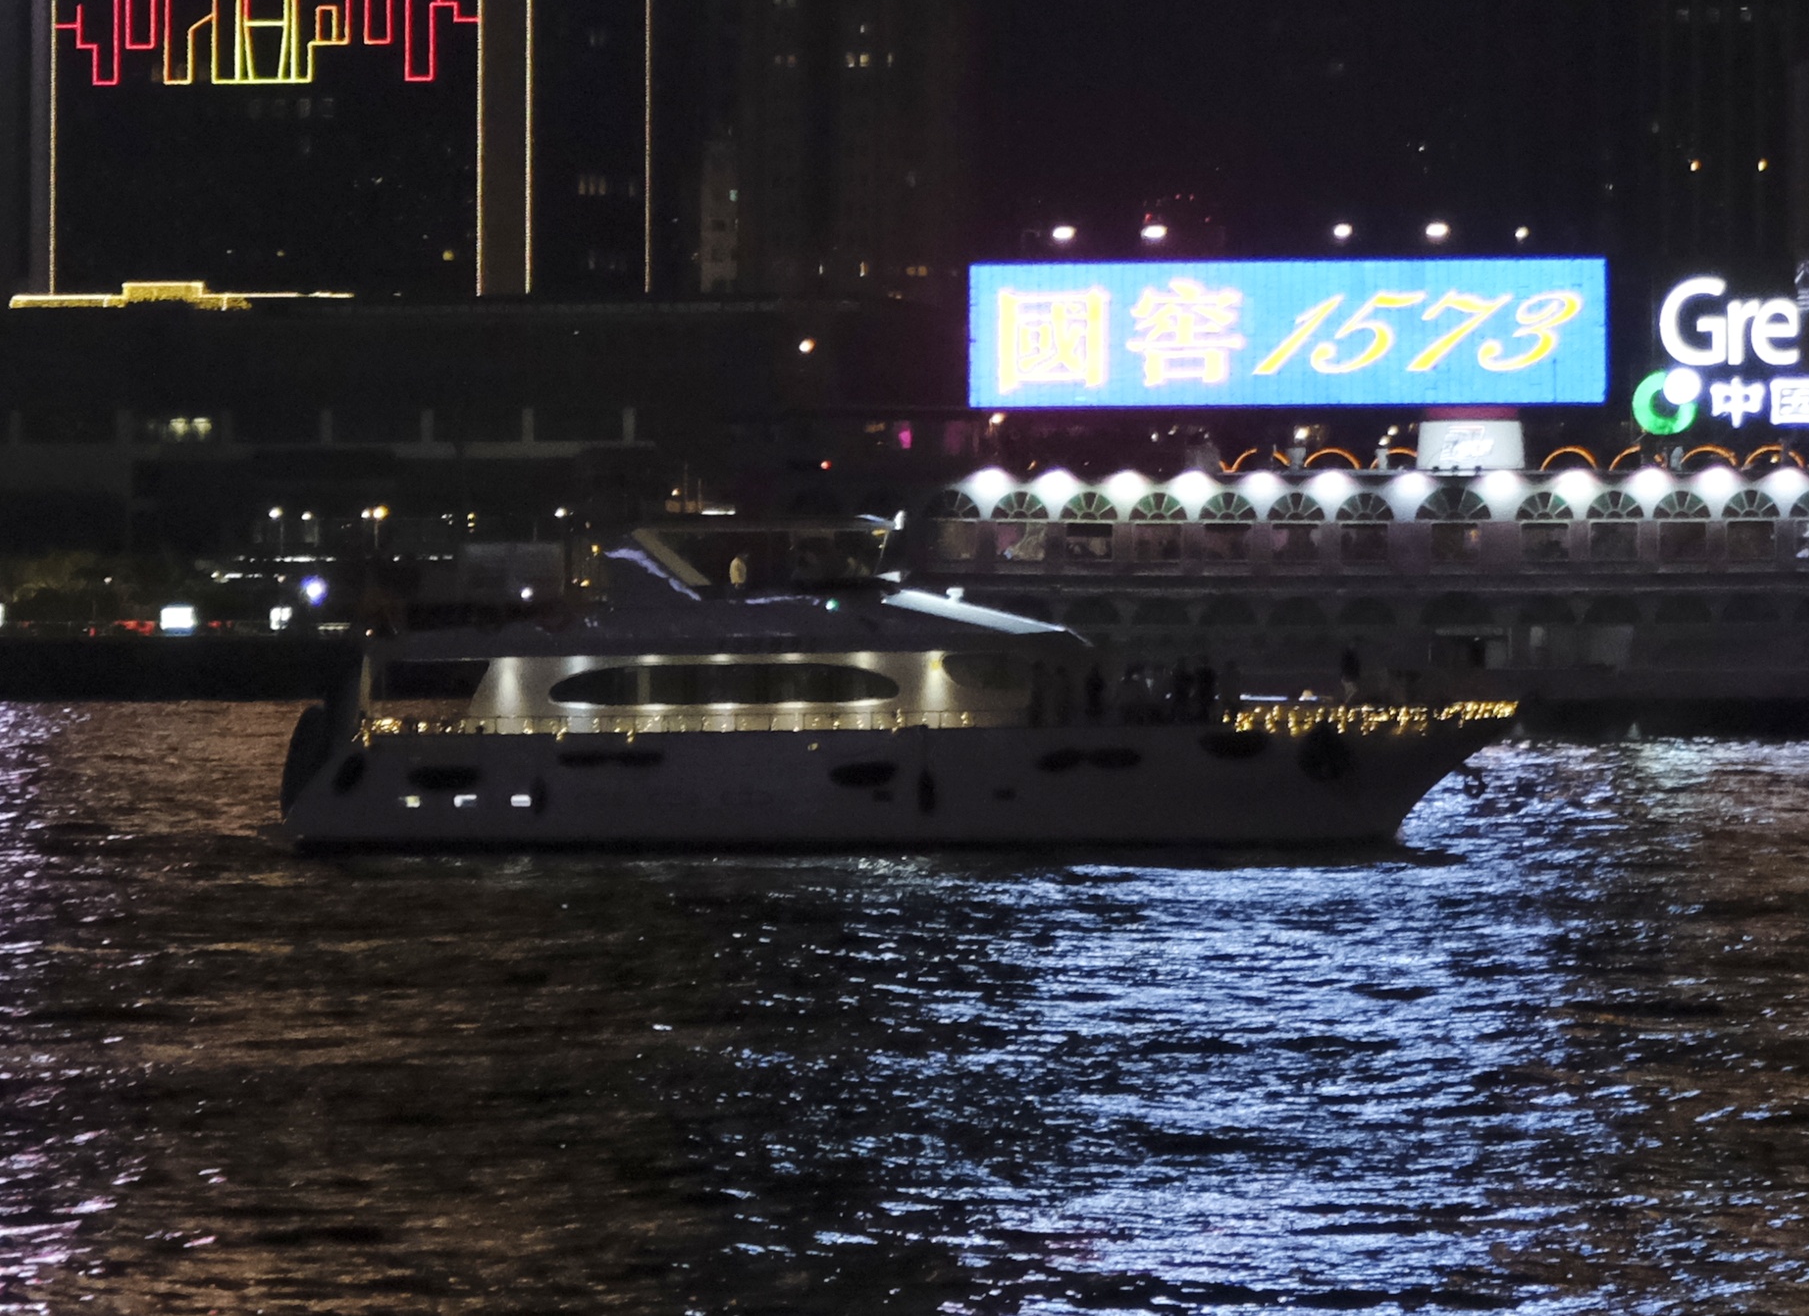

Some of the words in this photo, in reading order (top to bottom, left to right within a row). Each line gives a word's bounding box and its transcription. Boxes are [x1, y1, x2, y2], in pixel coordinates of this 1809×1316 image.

[995, 277, 1246, 395] 國窖
[1251, 288, 1585, 376] 1573
[1658, 275, 1801, 367] Gre
